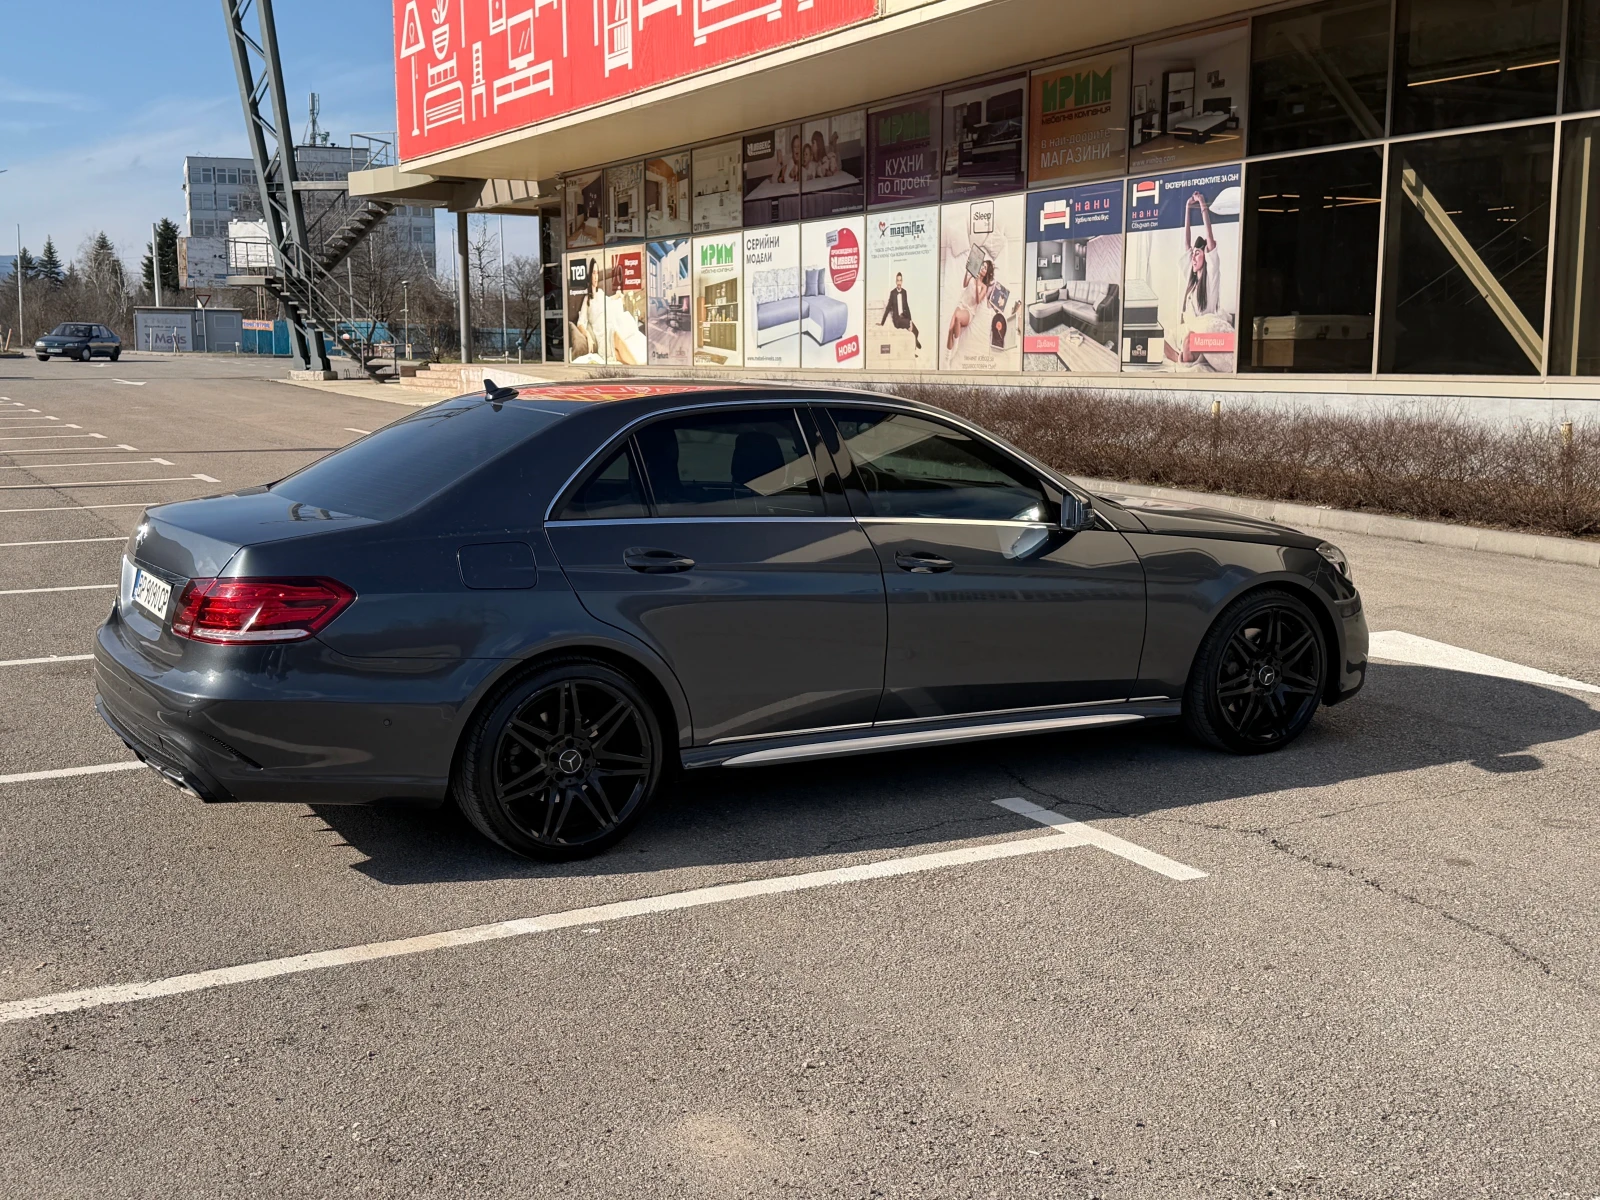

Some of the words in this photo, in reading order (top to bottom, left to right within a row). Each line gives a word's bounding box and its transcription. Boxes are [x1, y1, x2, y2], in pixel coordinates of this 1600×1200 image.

[1042, 66, 1112, 113] ИРИМ
[1040, 142, 1110, 168] МАГАЗИНИ
[885, 153, 924, 176] КУХНИ
[878, 181, 891, 194] по
[893, 174, 932, 195] проект
[890, 221, 925, 237] magniflex
[746, 234, 780, 251] СЕРИЙНИ
[701, 243, 734, 267] ИРИМ
[746, 252, 772, 265] МОДЕЛИ
[155, 333, 187, 344] Mais
[1194, 336, 1225, 348] Матраци
[838, 341, 857, 356] НОВО
